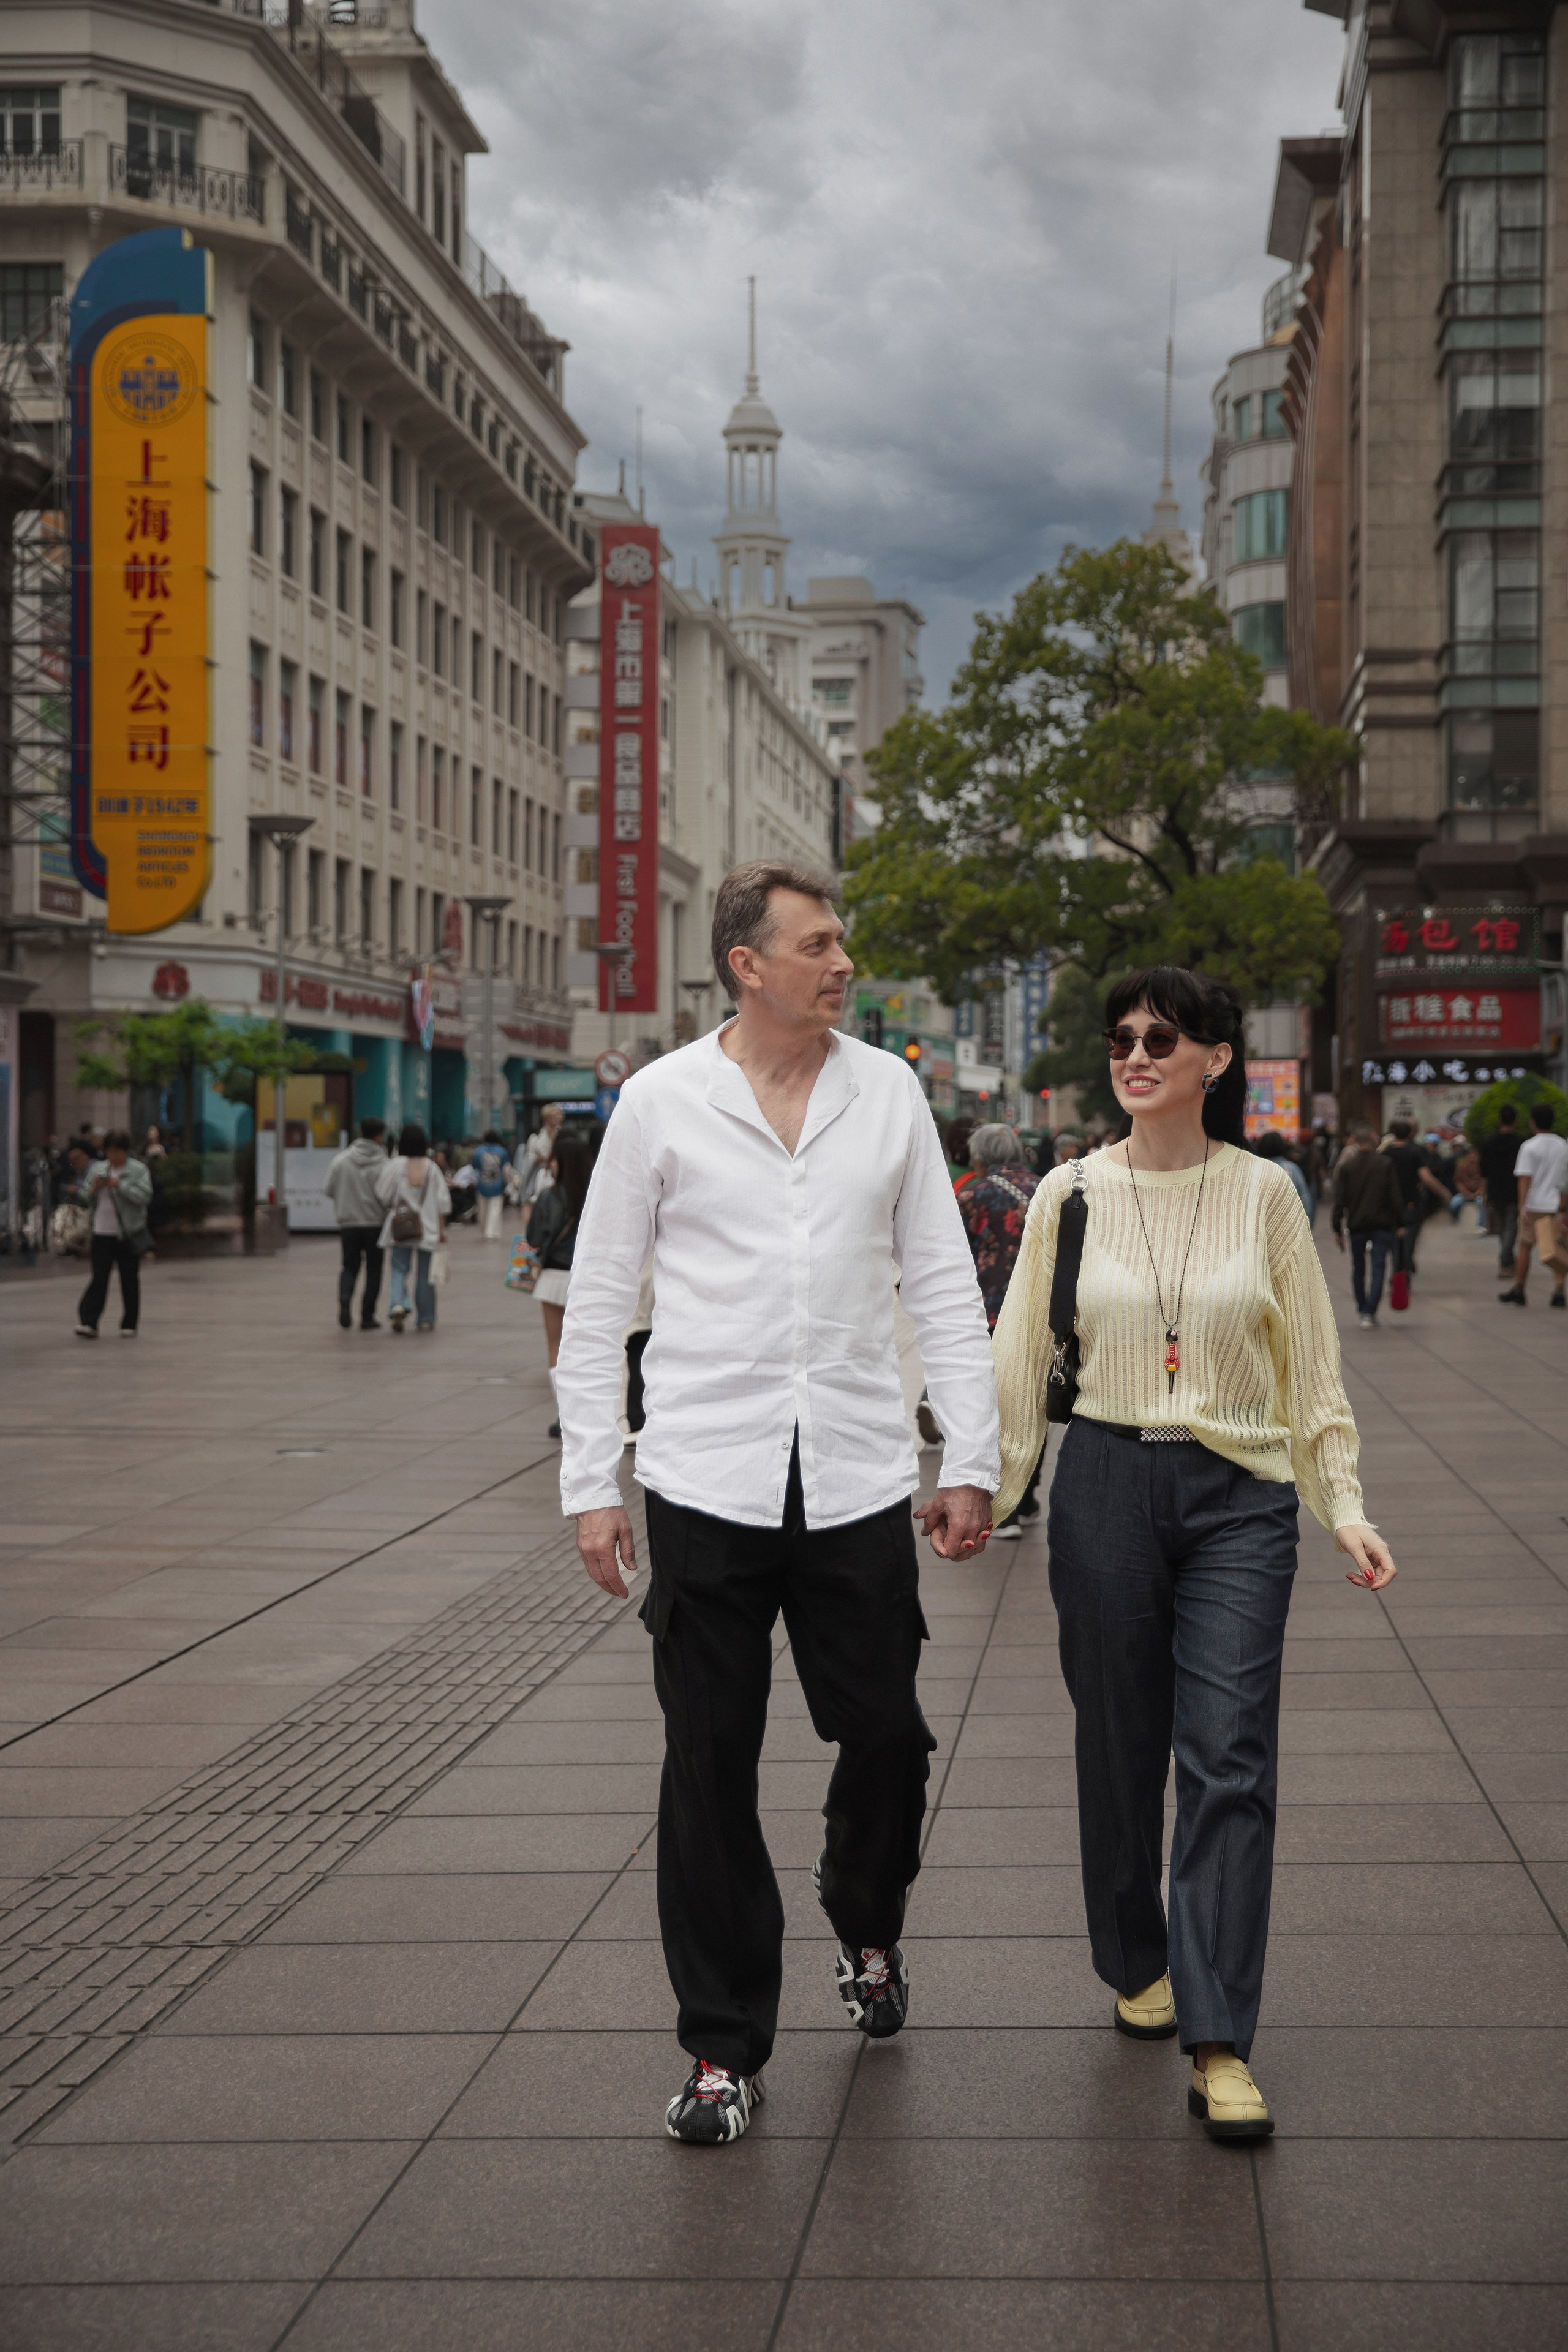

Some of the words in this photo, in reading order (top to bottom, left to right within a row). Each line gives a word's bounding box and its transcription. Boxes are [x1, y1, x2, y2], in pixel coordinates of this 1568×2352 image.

[125, 438, 172, 771] 上海帐子公司
[614, 598, 643, 841] 上海市第一食品商店
[616, 854, 638, 896] First
[616, 901, 638, 998] Foohall
[1389, 993, 1503, 1024] 新雅食品
